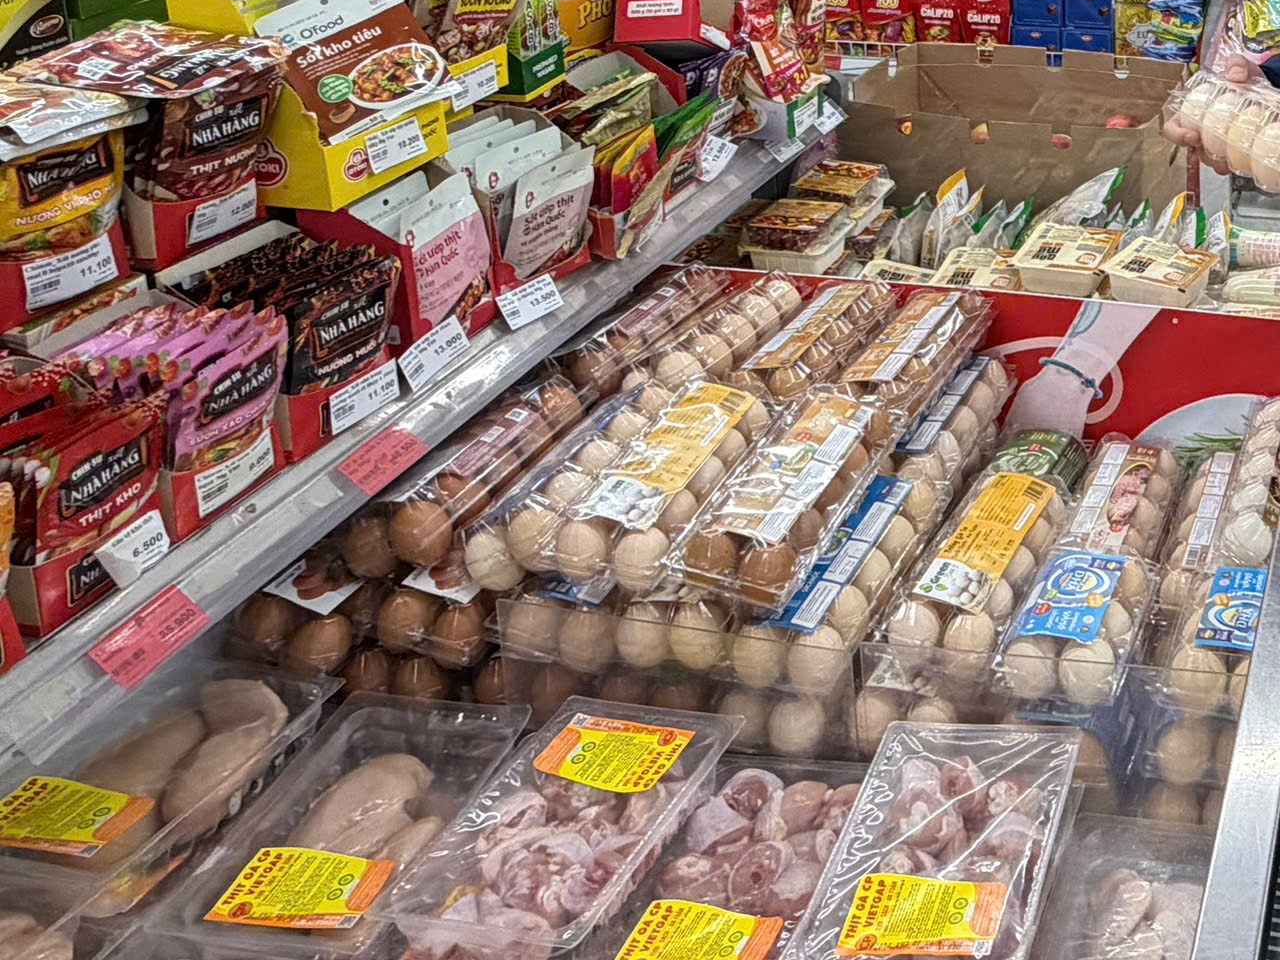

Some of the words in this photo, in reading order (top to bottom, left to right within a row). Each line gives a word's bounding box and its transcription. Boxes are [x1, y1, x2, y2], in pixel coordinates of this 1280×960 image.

[115, 482, 142, 507] KHO
[132, 531, 165, 559] 6.500
[929, 561, 952, 585] Green
